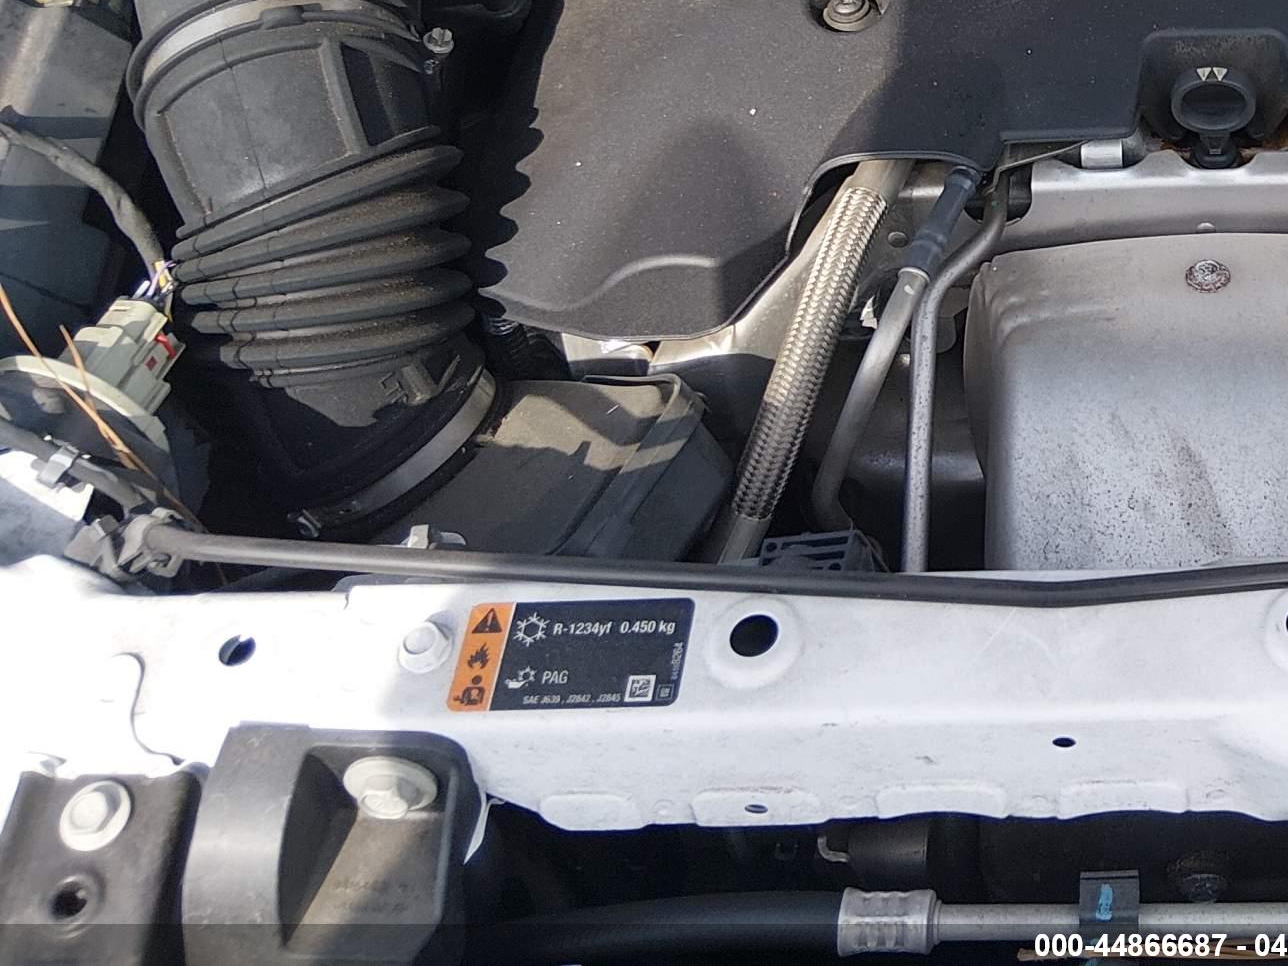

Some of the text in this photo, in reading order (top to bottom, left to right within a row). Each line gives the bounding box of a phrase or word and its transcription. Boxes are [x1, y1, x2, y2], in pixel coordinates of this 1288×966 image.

[552, 621, 676, 638] R-1234yf 0.450 kg
[541, 669, 569, 685] PAG
[522, 695, 540, 705] SAE
